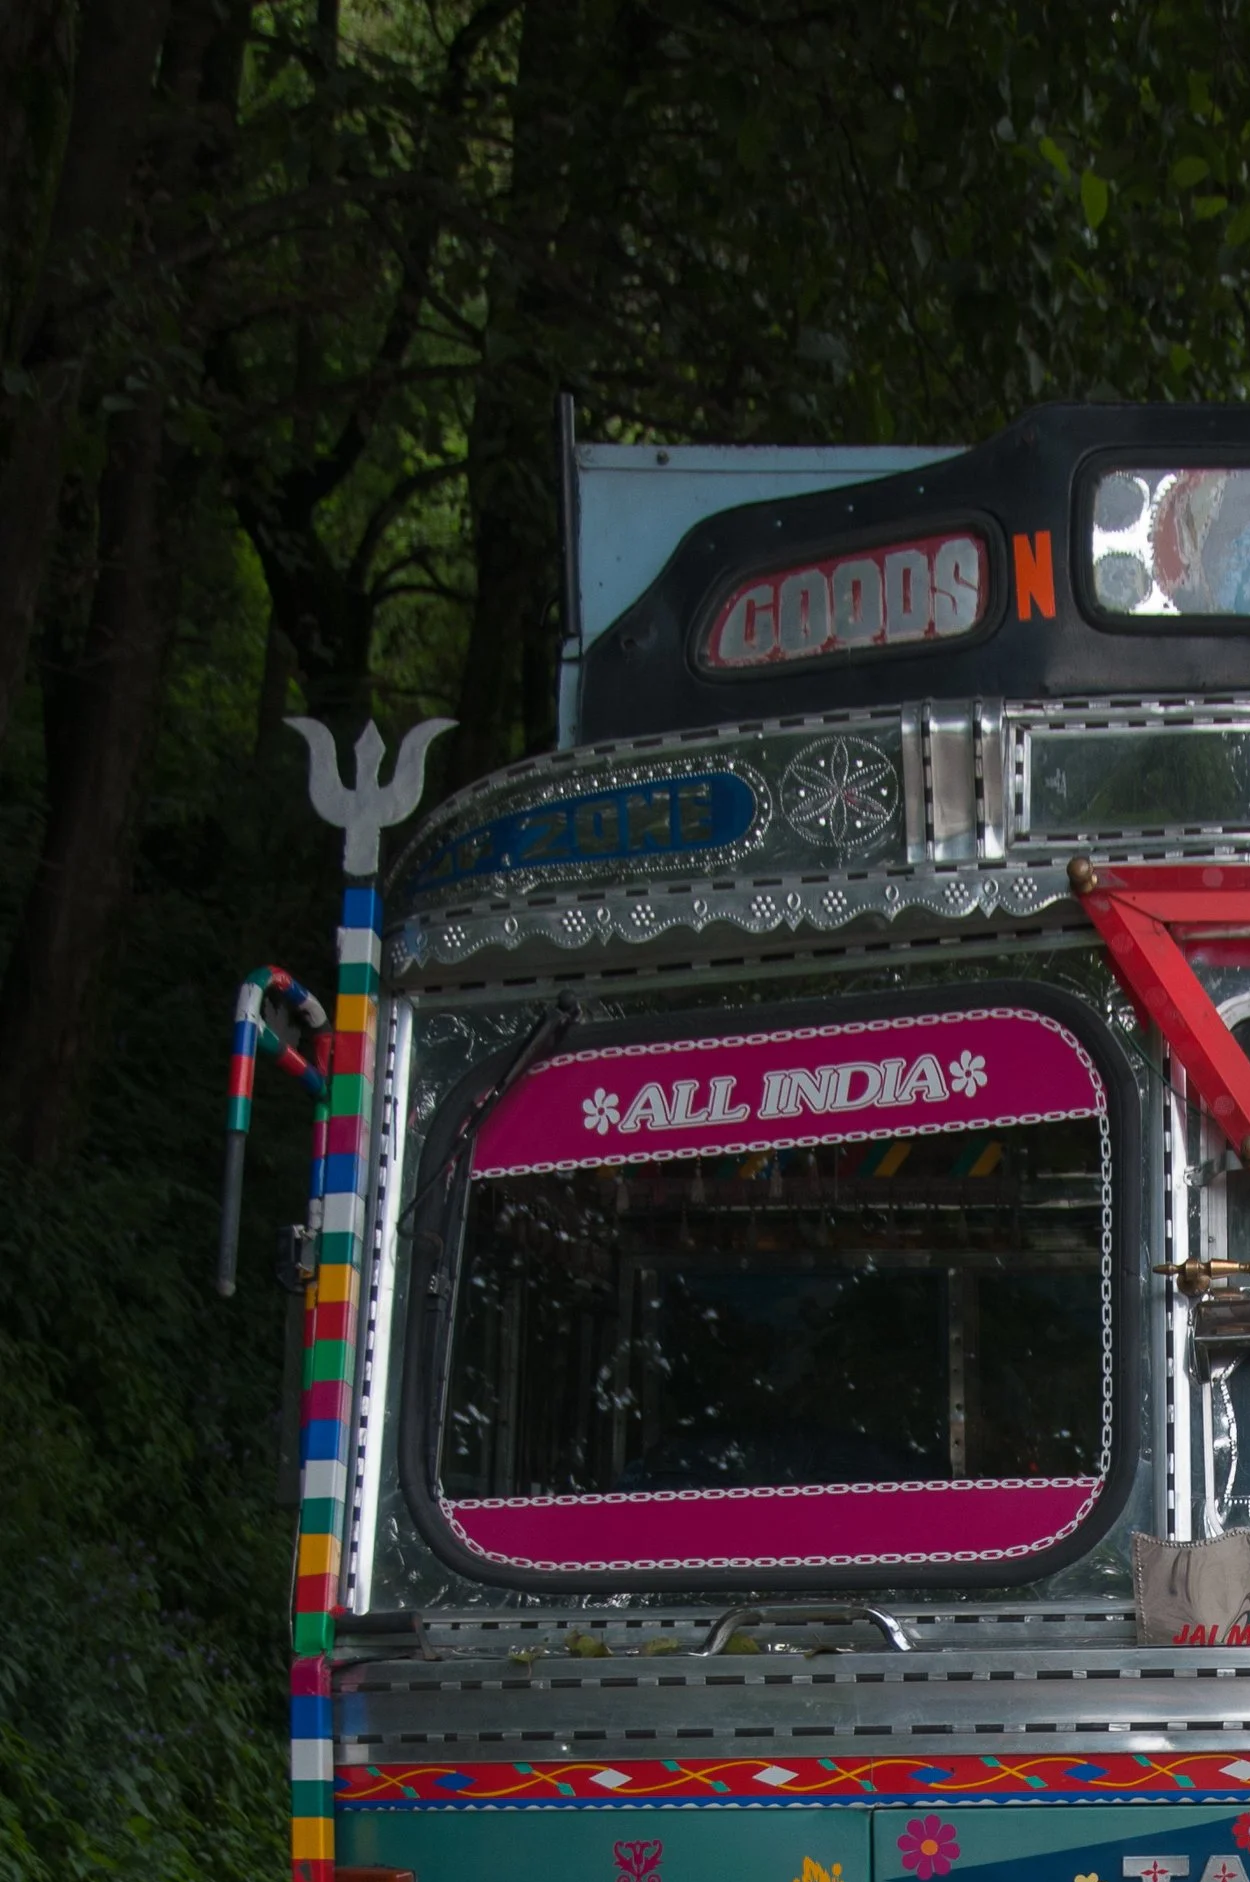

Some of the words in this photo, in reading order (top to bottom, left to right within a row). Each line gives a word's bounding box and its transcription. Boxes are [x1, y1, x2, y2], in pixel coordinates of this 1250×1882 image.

[719, 538, 978, 657] GOODS
[1013, 531, 1056, 621] N
[519, 781, 713, 861] ZONE
[618, 1076, 750, 1132] ALL
[758, 1053, 950, 1119] INDIA
[1172, 1624, 1219, 1646] JAI
